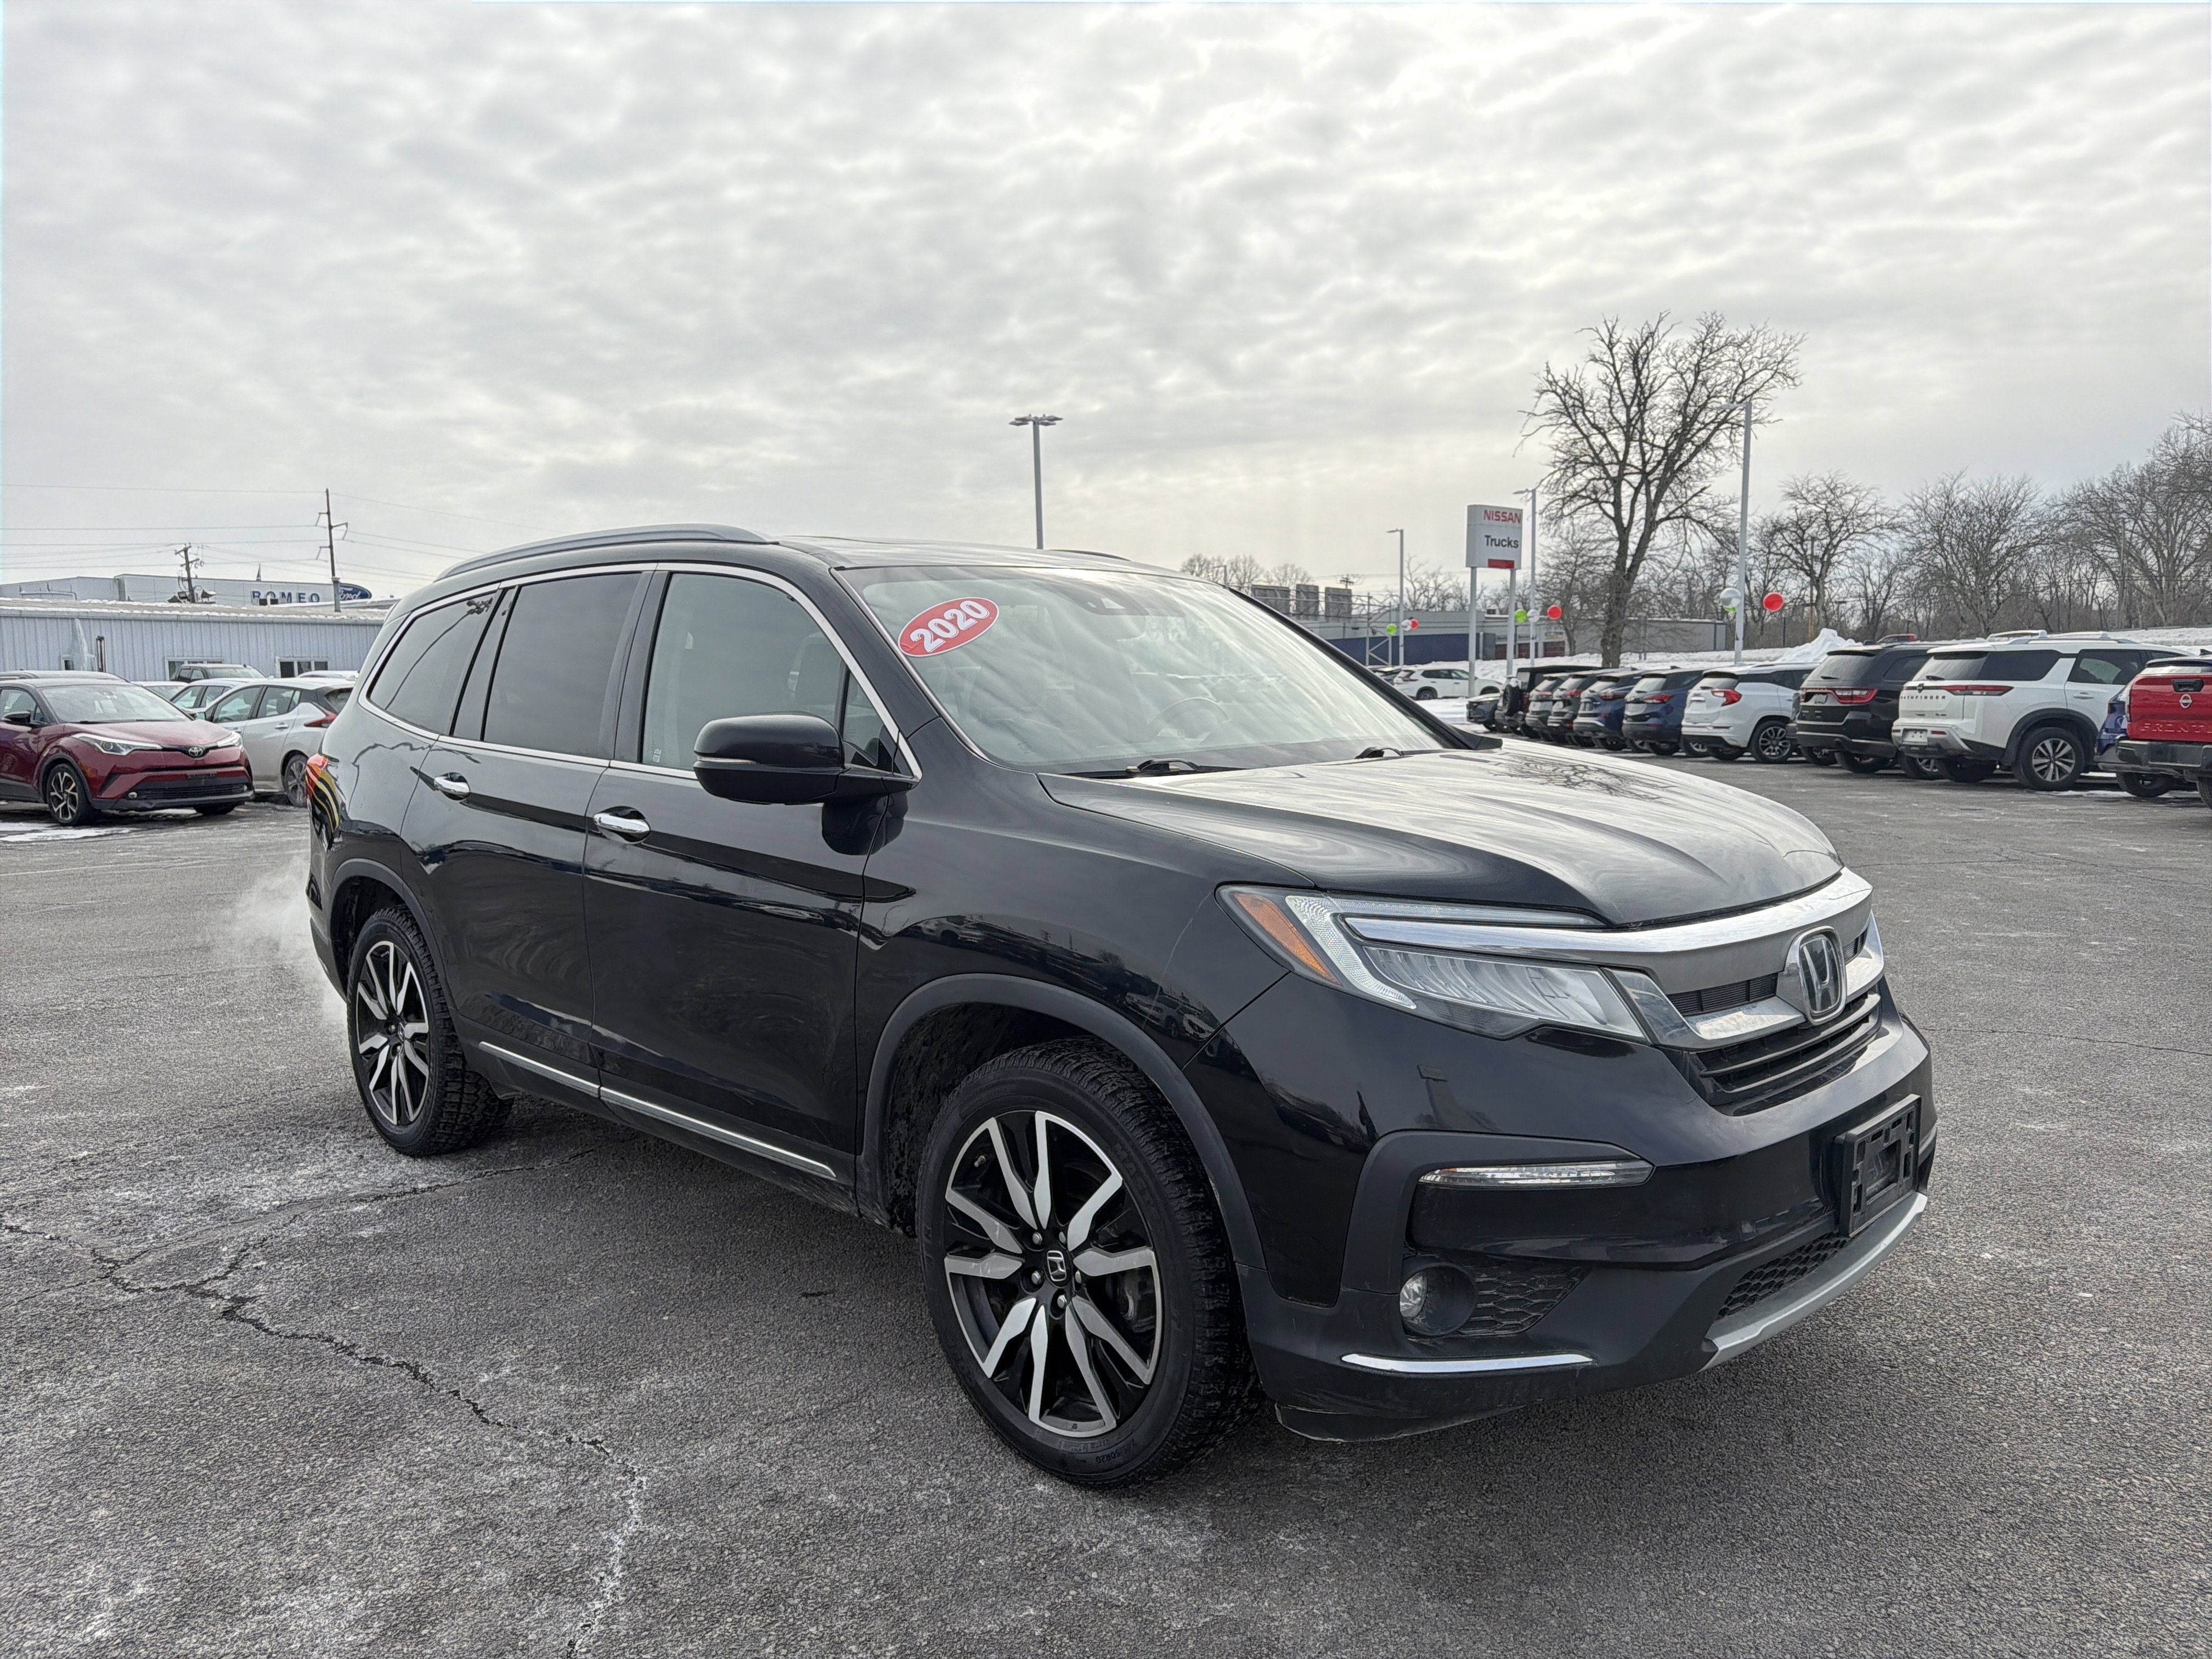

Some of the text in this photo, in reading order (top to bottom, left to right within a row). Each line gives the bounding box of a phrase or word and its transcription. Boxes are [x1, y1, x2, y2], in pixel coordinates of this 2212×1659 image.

[1483, 509, 1521, 523] NISSAN
[1485, 534, 1519, 548] Trucks
[252, 590, 320, 603] ROMEO
[910, 600, 990, 652] 2020
